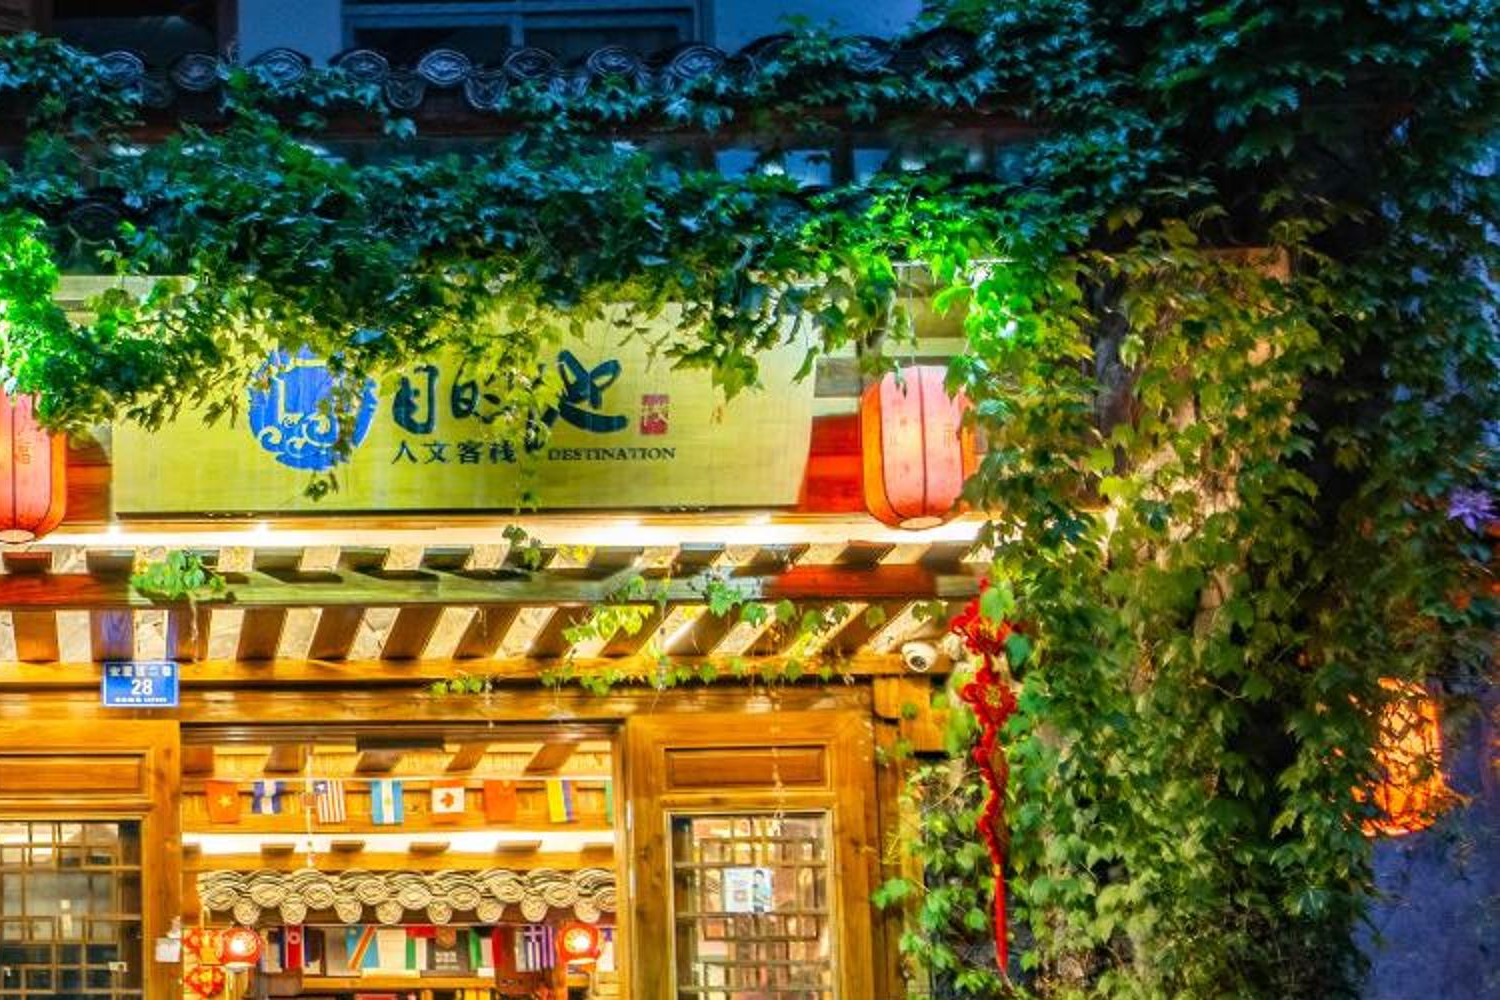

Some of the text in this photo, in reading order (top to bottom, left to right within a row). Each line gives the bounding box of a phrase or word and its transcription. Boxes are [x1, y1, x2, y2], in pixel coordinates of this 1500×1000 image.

[392, 440, 517, 465] 人文客栈
[548, 447, 677, 461] DESTINATION
[131, 678, 153, 695] 28
